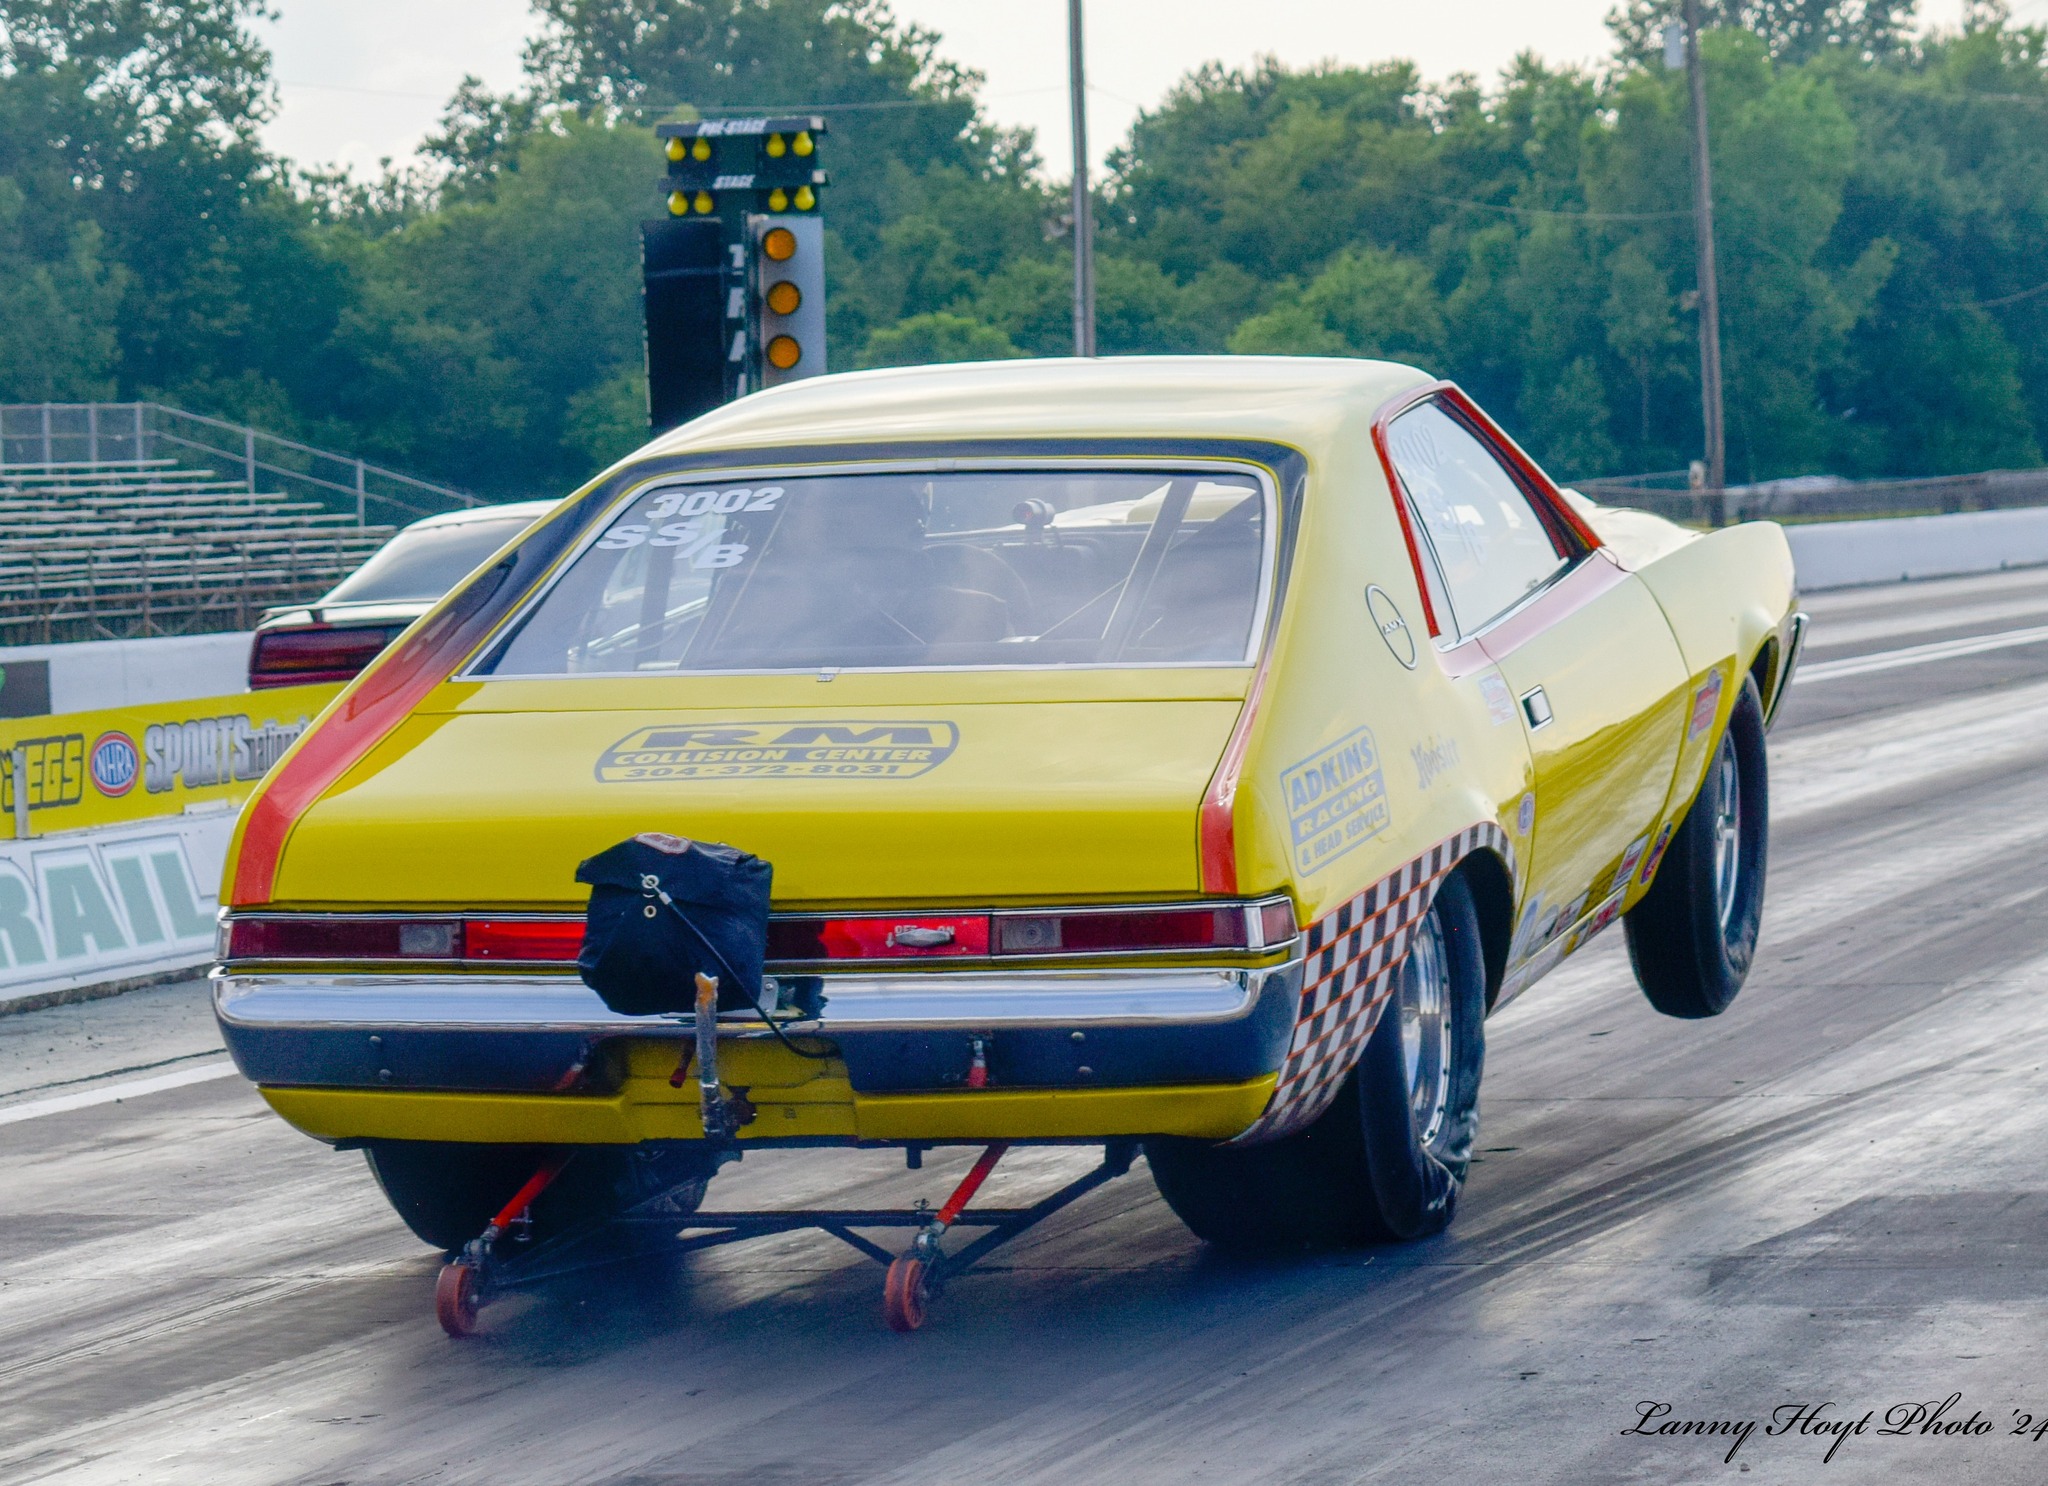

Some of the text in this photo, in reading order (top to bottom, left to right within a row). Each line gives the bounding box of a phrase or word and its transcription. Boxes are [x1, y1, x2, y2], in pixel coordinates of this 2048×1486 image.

[712, 174, 756, 190] STAGE
[645, 487, 785, 519] 3002
[641, 727, 934, 748] RM
[95, 741, 135, 787] NHRA
[614, 747, 931, 765] COLLISION CENTER
[625, 765, 901, 778] 304-372-8031
[1290, 735, 1374, 812] ADKINS
[1299, 778, 1378, 838] RACING
[1314, 829, 1342, 858] HEAD
[1345, 802, 1386, 840] SERVICE
